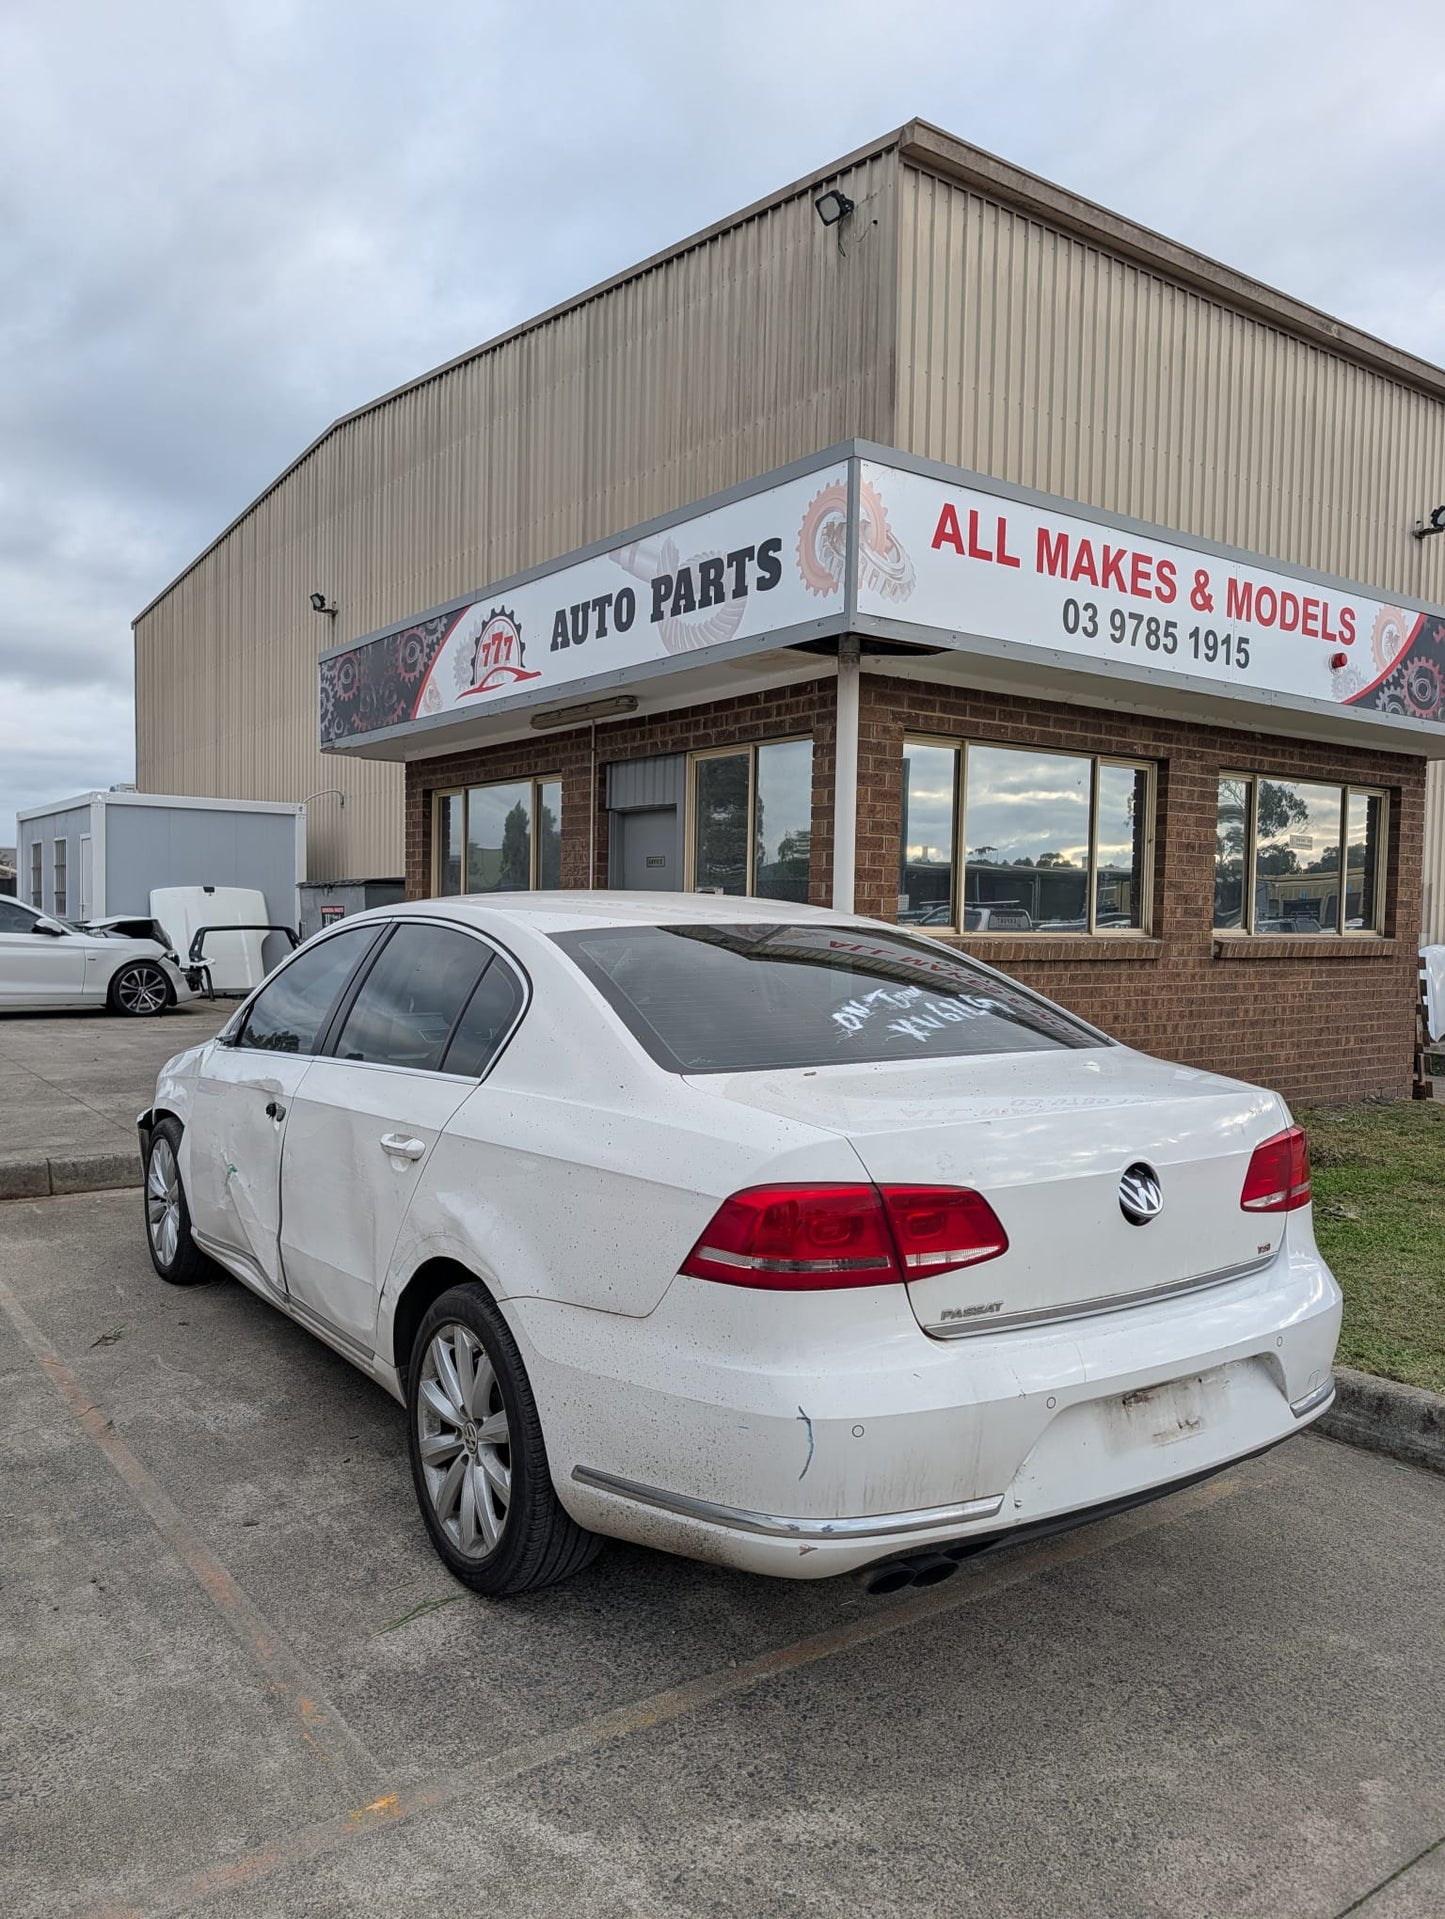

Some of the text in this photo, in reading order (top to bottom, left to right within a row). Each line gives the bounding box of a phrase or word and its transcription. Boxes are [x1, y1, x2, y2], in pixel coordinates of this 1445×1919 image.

[550, 537, 782, 652] AUTO PARTS
[931, 503, 1356, 646] ALL MAKES & MODELS
[482, 631, 514, 668] 777
[1062, 598, 1250, 669] 03 9785 1915
[940, 1301, 1004, 1321] PASSAT
